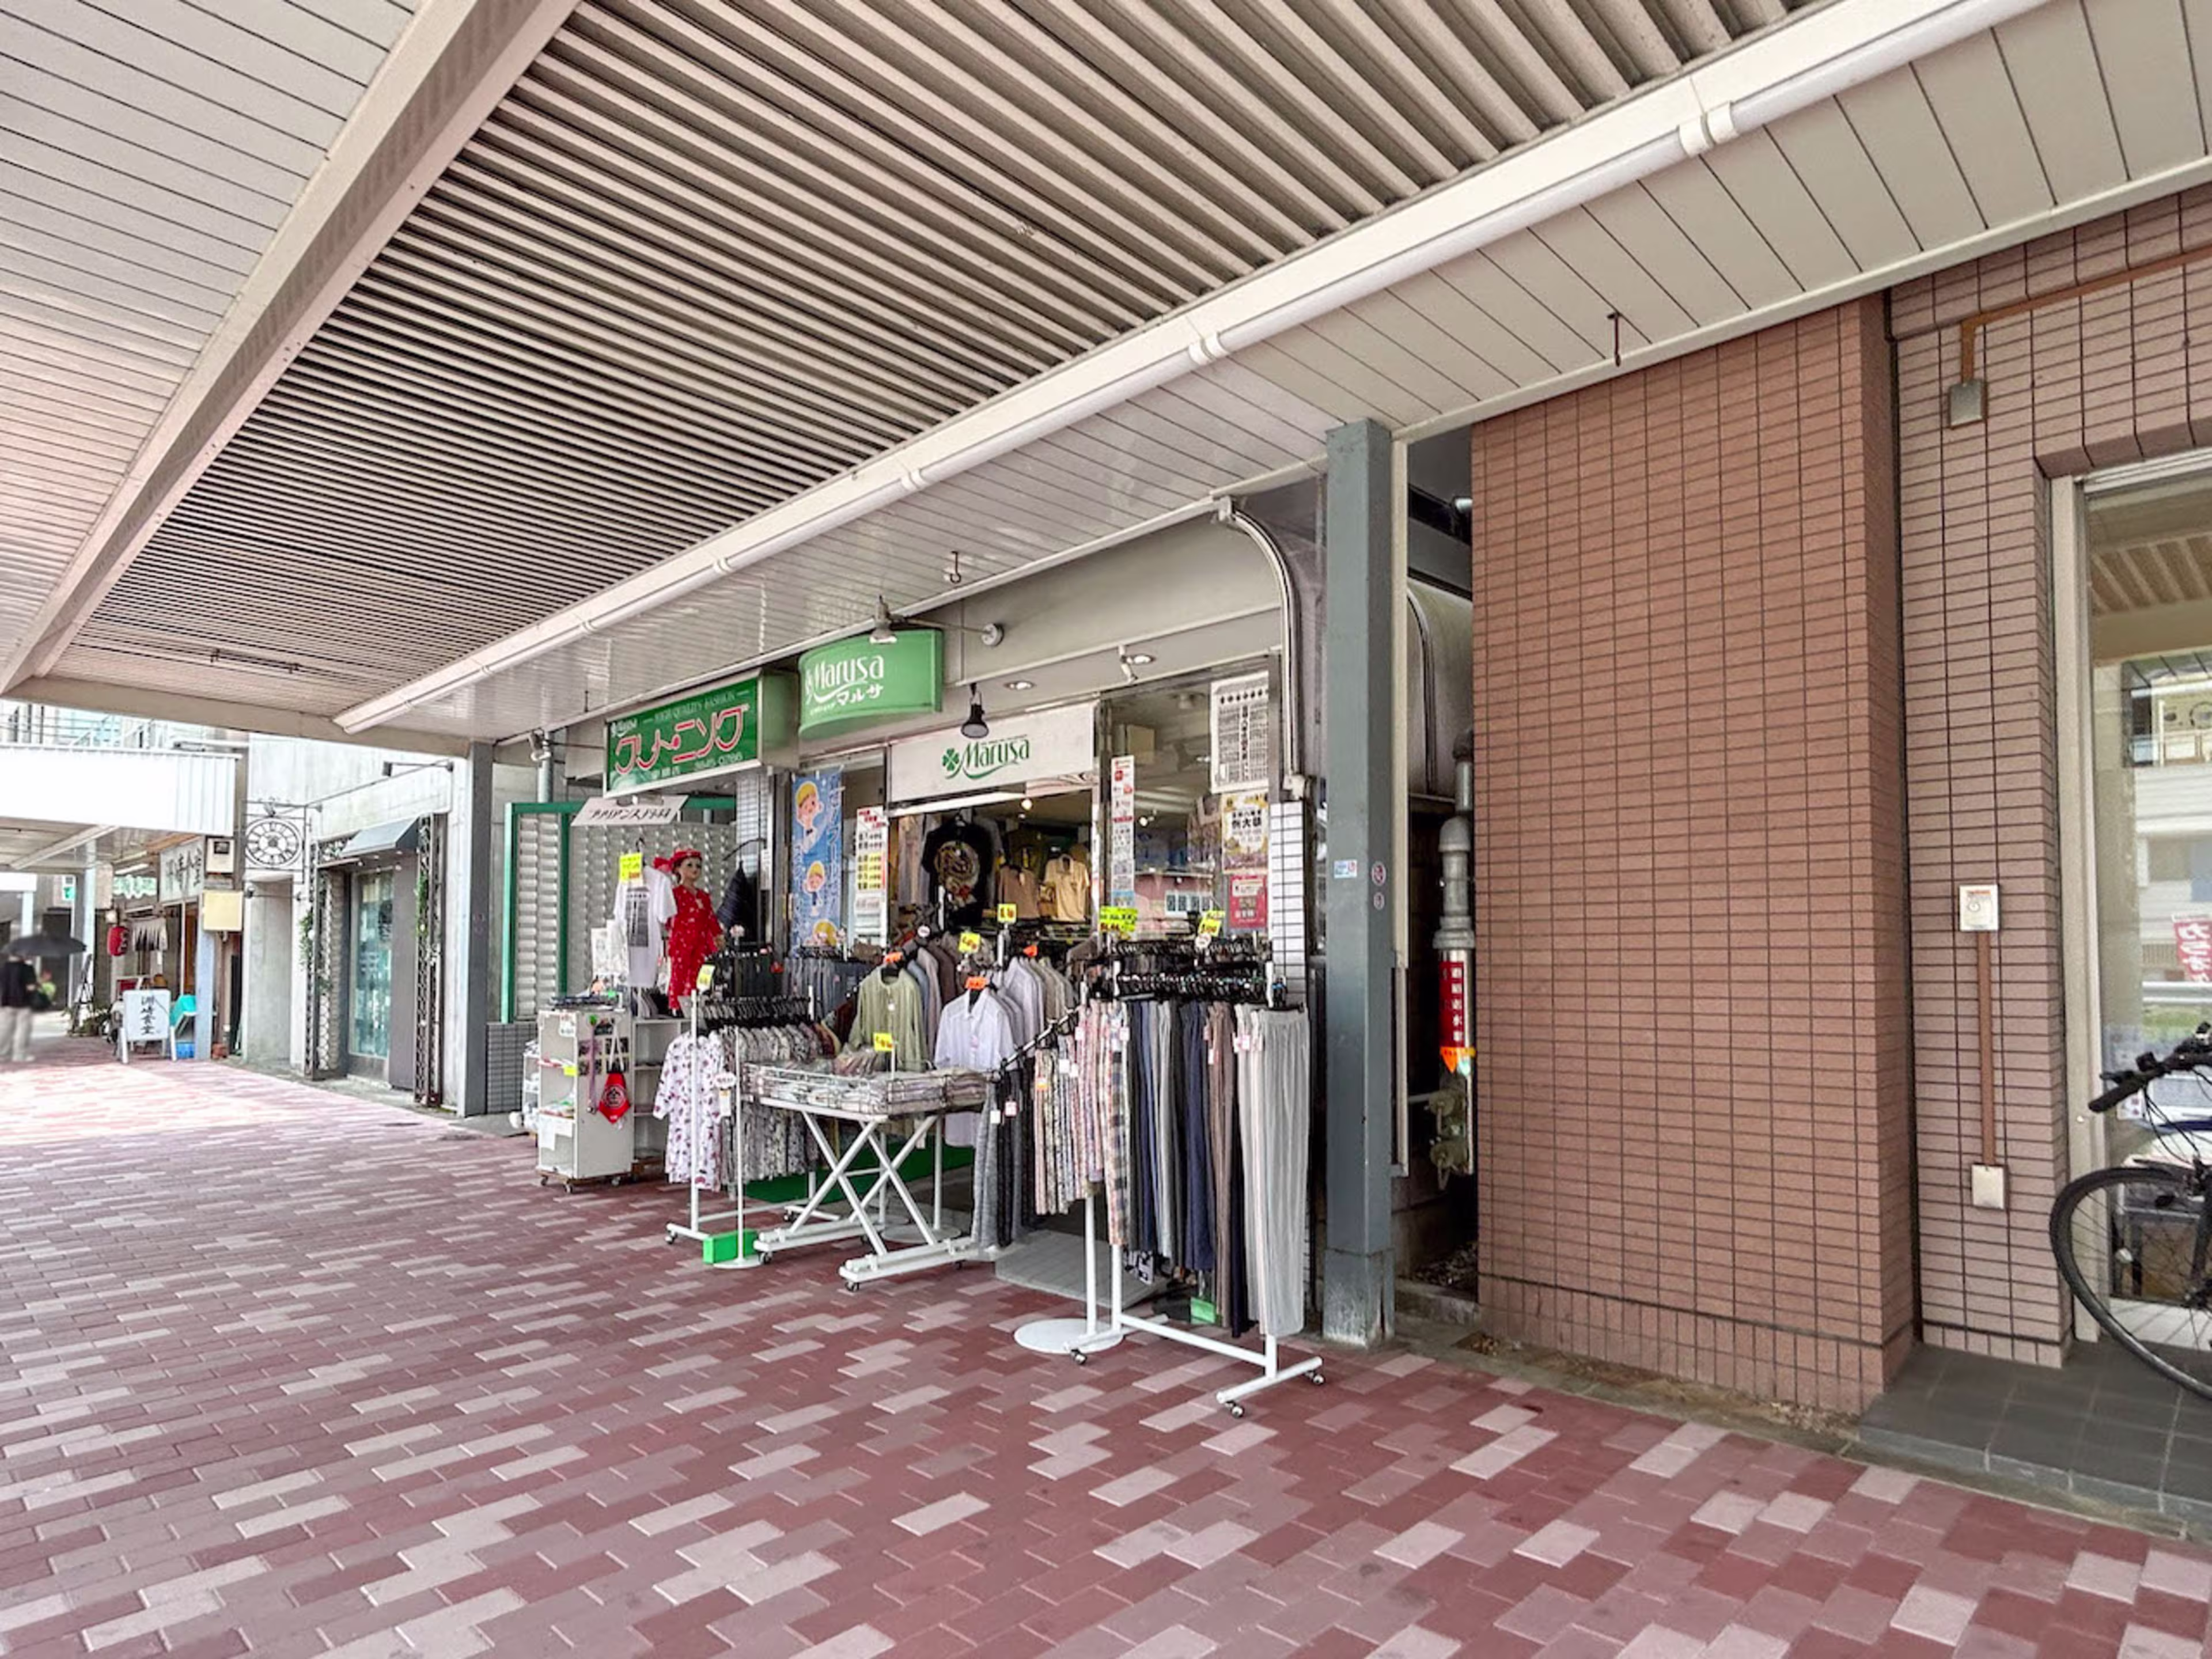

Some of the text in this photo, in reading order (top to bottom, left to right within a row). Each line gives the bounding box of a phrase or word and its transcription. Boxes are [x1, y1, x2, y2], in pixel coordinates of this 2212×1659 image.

[814, 654, 884, 694] Marusa
[836, 683, 884, 706] マルサ
[614, 703, 750, 775] クリーニング
[963, 738, 1029, 771] Marusa
